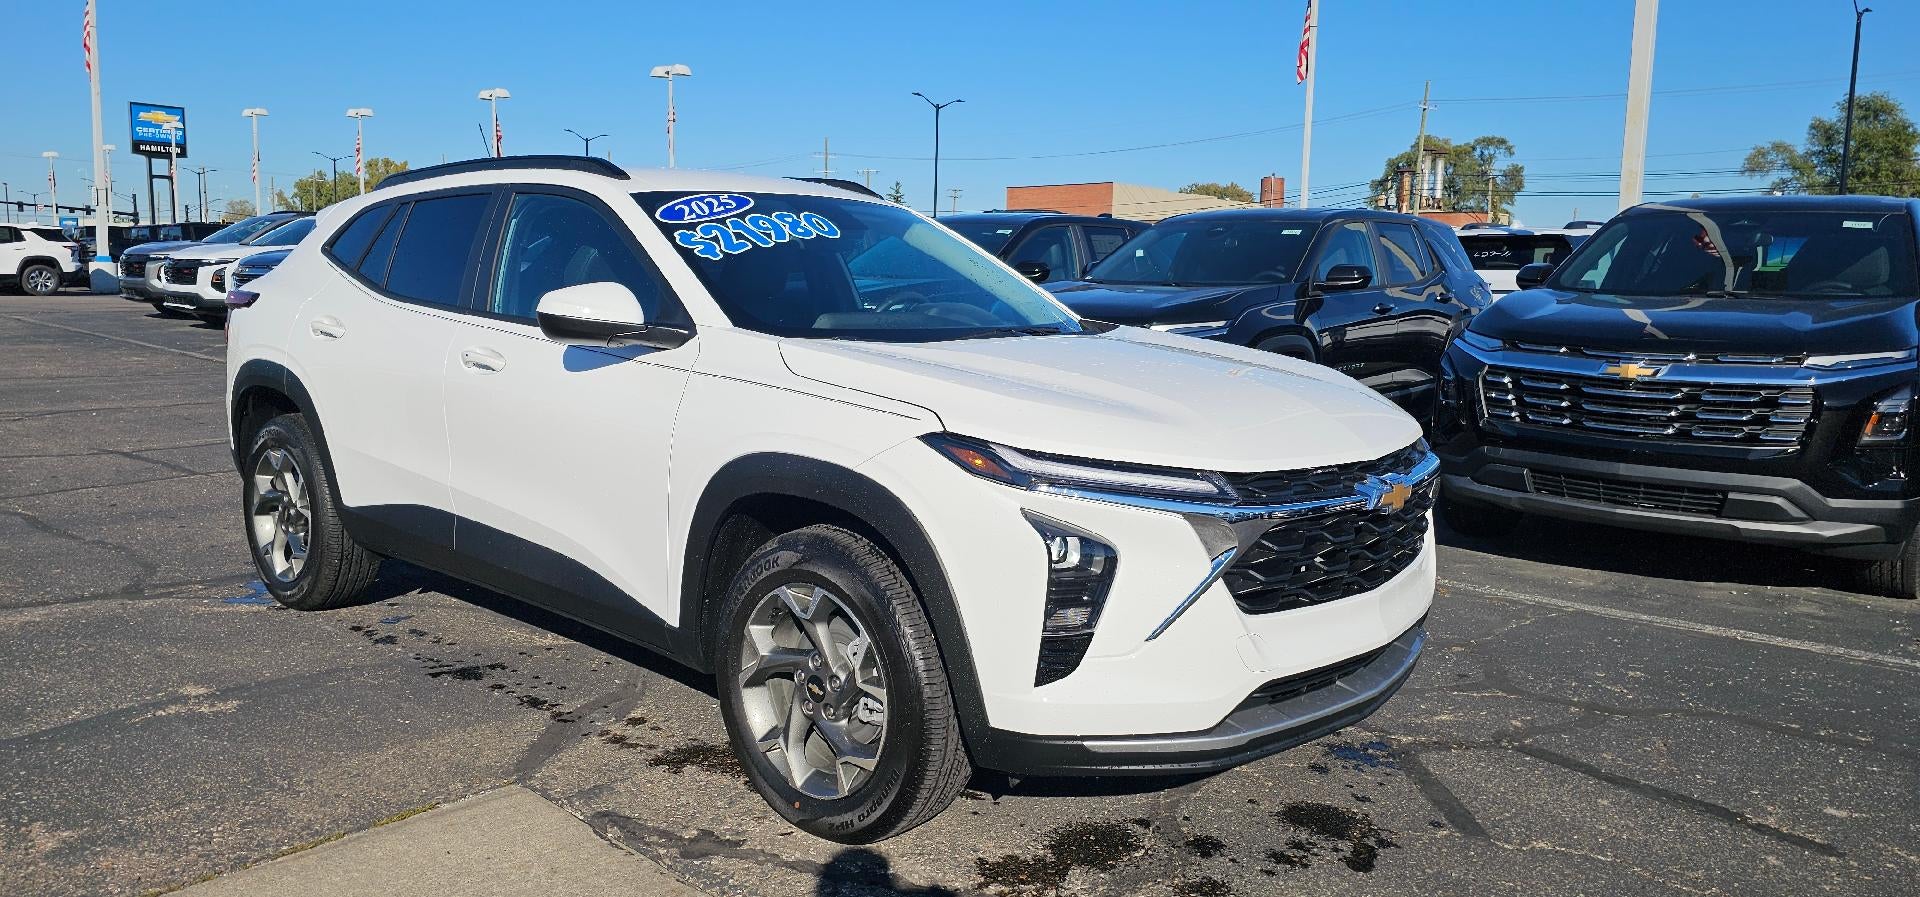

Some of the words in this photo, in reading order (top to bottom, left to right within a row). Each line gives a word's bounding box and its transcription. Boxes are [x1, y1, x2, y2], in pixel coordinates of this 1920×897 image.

[136, 126, 182, 136] CERTIFID
[138, 131, 181, 139] PRE-OWND
[674, 195, 736, 219] 2025
[673, 211, 841, 261] $21980
